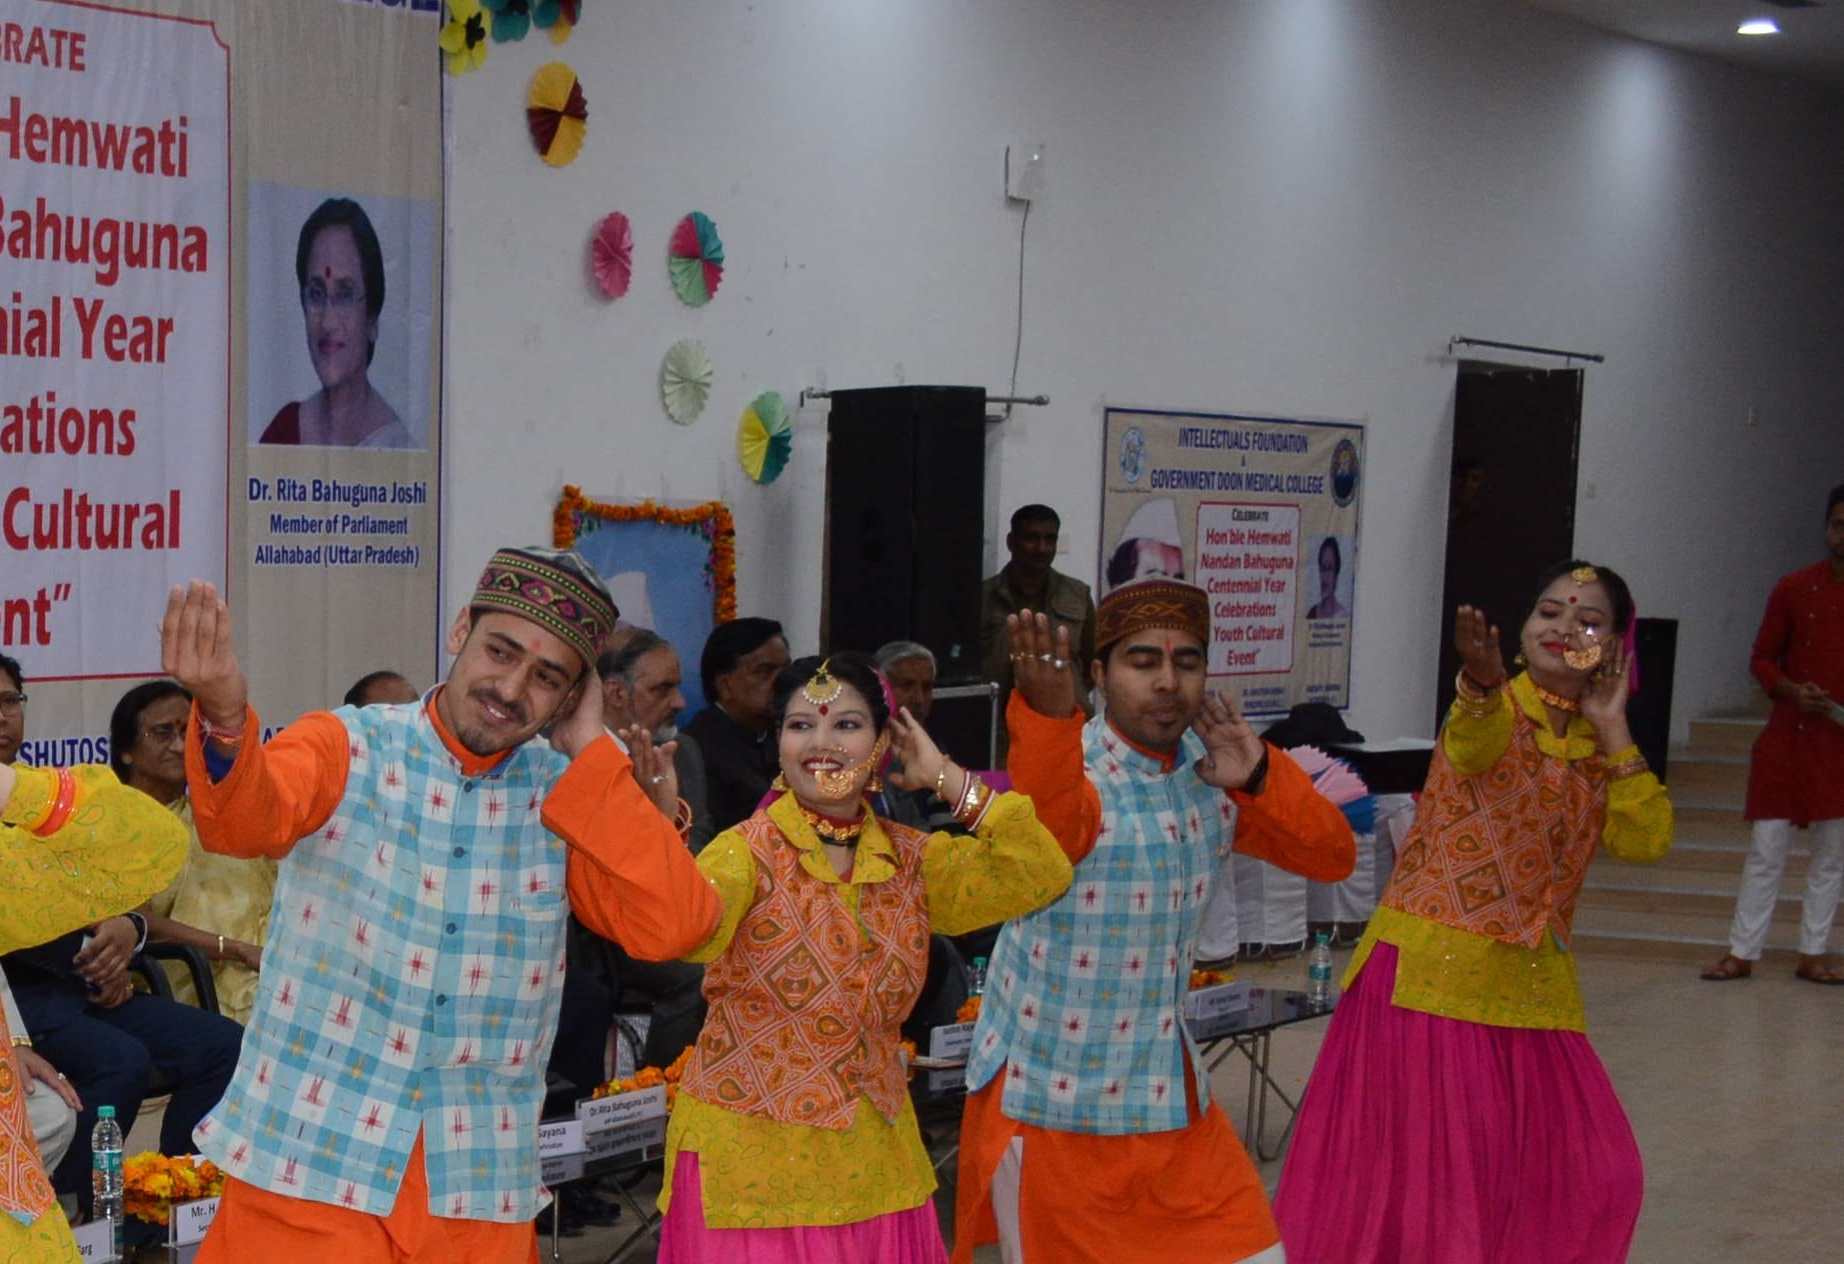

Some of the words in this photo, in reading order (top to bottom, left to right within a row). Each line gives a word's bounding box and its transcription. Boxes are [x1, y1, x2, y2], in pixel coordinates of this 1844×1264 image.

[73, 297, 174, 363] Year
[1178, 427, 1250, 450] INTELLECTUALS
[1252, 432, 1308, 454] FOUNDATION
[1150, 468, 1216, 491] GOVERNMENT
[1217, 472, 1244, 492] DOON
[1245, 474, 1285, 493] MEDICAL
[1287, 475, 1325, 495] COLLEGE
[249, 478, 272, 501] Dr.
[277, 478, 307, 502] Rita
[312, 479, 387, 508] Bahuguna
[390, 481, 427, 504] Joshi
[2, 486, 181, 551] Cultural
[270, 513, 323, 534] Member
[325, 513, 340, 534] of
[342, 514, 408, 535] Parliament
[1247, 529, 1292, 546] Hemwati
[255, 545, 321, 565] Allahabad
[324, 545, 363, 568] (Uttar
[365, 545, 420, 568] Pradesh)
[1201, 553, 1241, 570] Nandan
[1244, 554, 1294, 575] Bahuguna
[1207, 576, 1261, 594] Centennial
[1265, 577, 1286, 594] Year
[1214, 602, 1277, 618] Celebrations
[1214, 626, 1244, 642] Youth
[1246, 625, 1284, 641] Cultural
